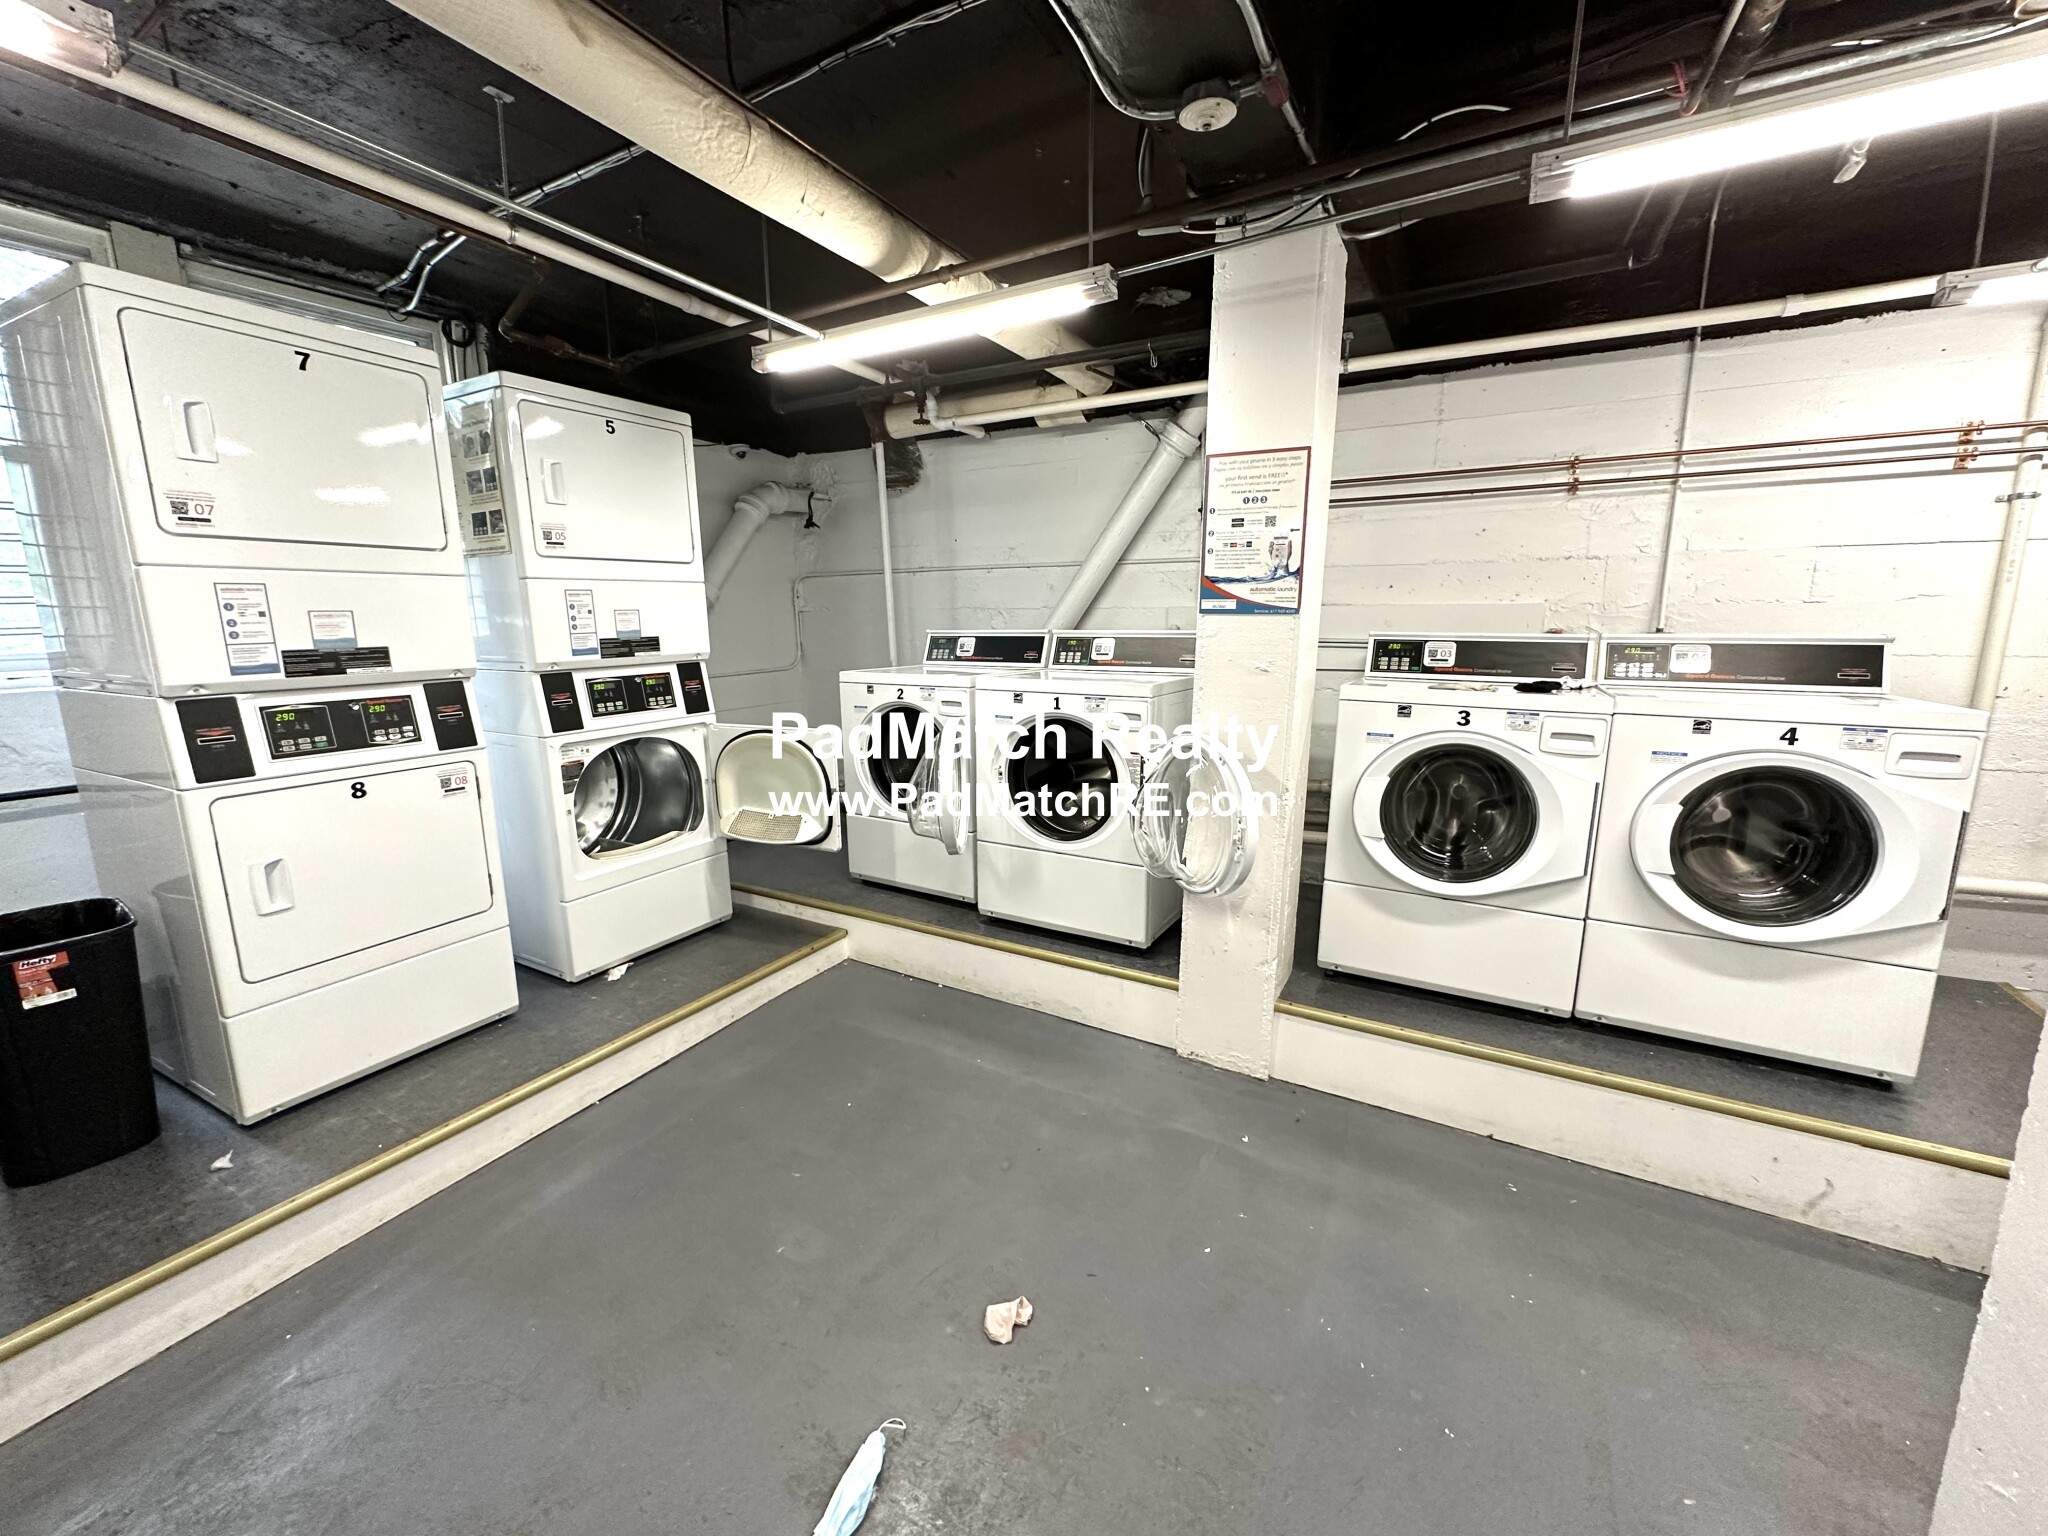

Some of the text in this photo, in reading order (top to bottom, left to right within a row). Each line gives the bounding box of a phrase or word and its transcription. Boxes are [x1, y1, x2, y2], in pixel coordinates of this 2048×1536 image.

[294, 350, 310, 371] 7
[606, 419, 616, 434] 5
[194, 504, 214, 515] 07
[555, 532, 566, 540] 05
[897, 688, 904, 699] 2
[1054, 697, 1061, 710] 1
[1456, 710, 1471, 726] 3
[1780, 727, 1799, 745] 4
[455, 776, 468, 785] 08
[350, 782, 367, 799] 8
[21, 956, 55, 968] Hefty
